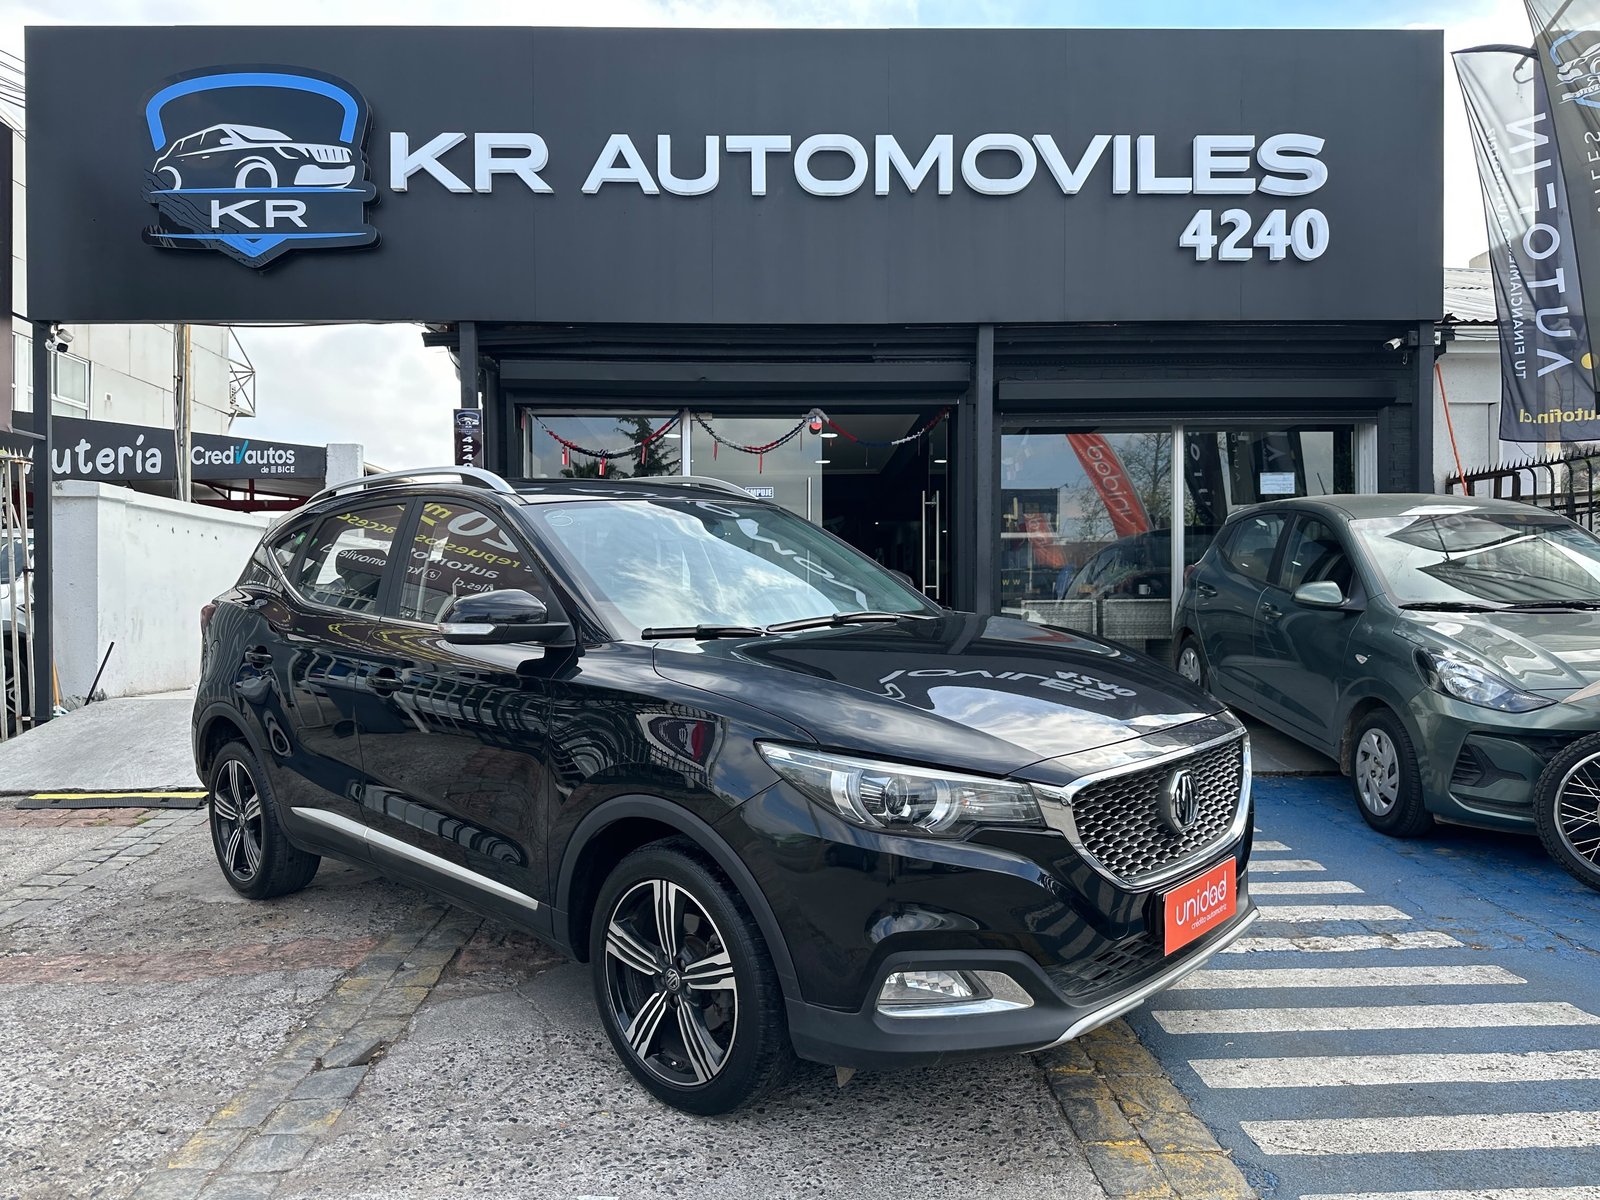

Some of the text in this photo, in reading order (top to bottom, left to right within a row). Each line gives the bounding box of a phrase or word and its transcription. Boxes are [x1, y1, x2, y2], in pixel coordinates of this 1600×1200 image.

[390, 131, 1329, 197] KR AUTOMOVILES
[210, 199, 308, 228] KR
[1179, 208, 1329, 261] 4240
[51, 434, 162, 475] utería
[277, 465, 296, 473] BICE
[1176, 870, 1228, 926] unidad
